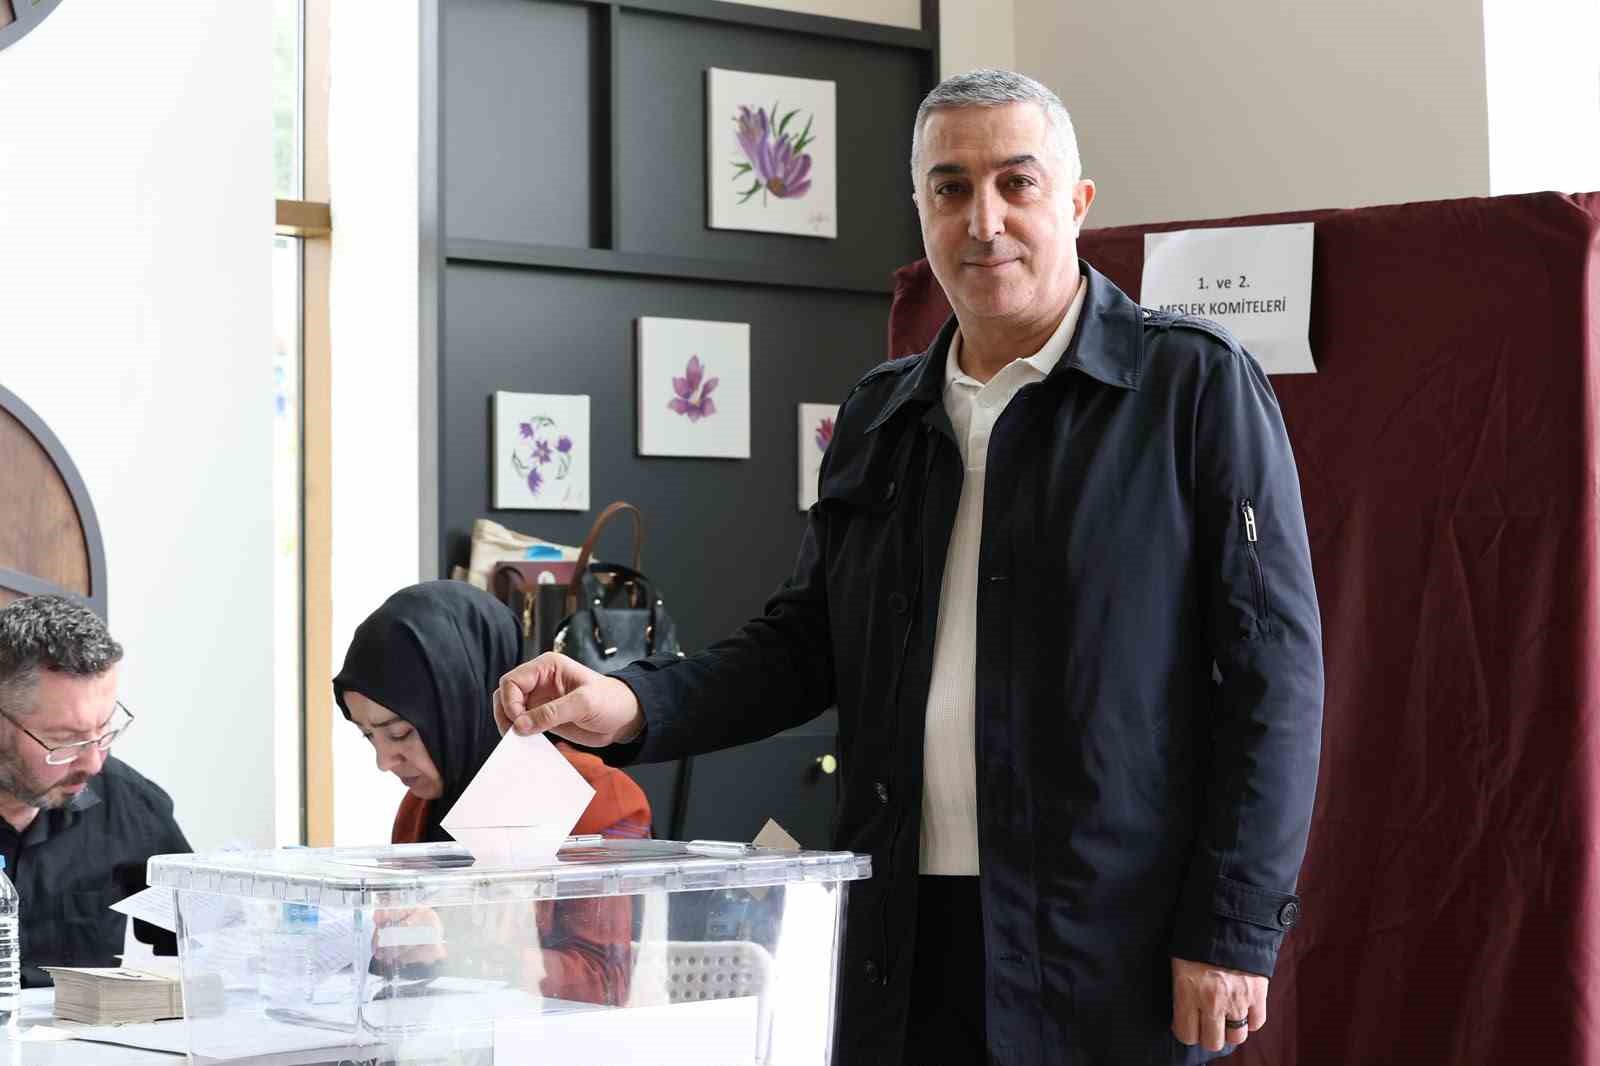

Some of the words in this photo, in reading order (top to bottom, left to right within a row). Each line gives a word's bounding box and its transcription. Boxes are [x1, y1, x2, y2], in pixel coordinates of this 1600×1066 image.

[1198, 277, 1209, 290] 1.
[1216, 279, 1232, 289] ve
[1239, 275, 1250, 288] 2.
[1159, 303, 1206, 316] MESLEK
[1209, 297, 1286, 315] KOMİTELERİ
